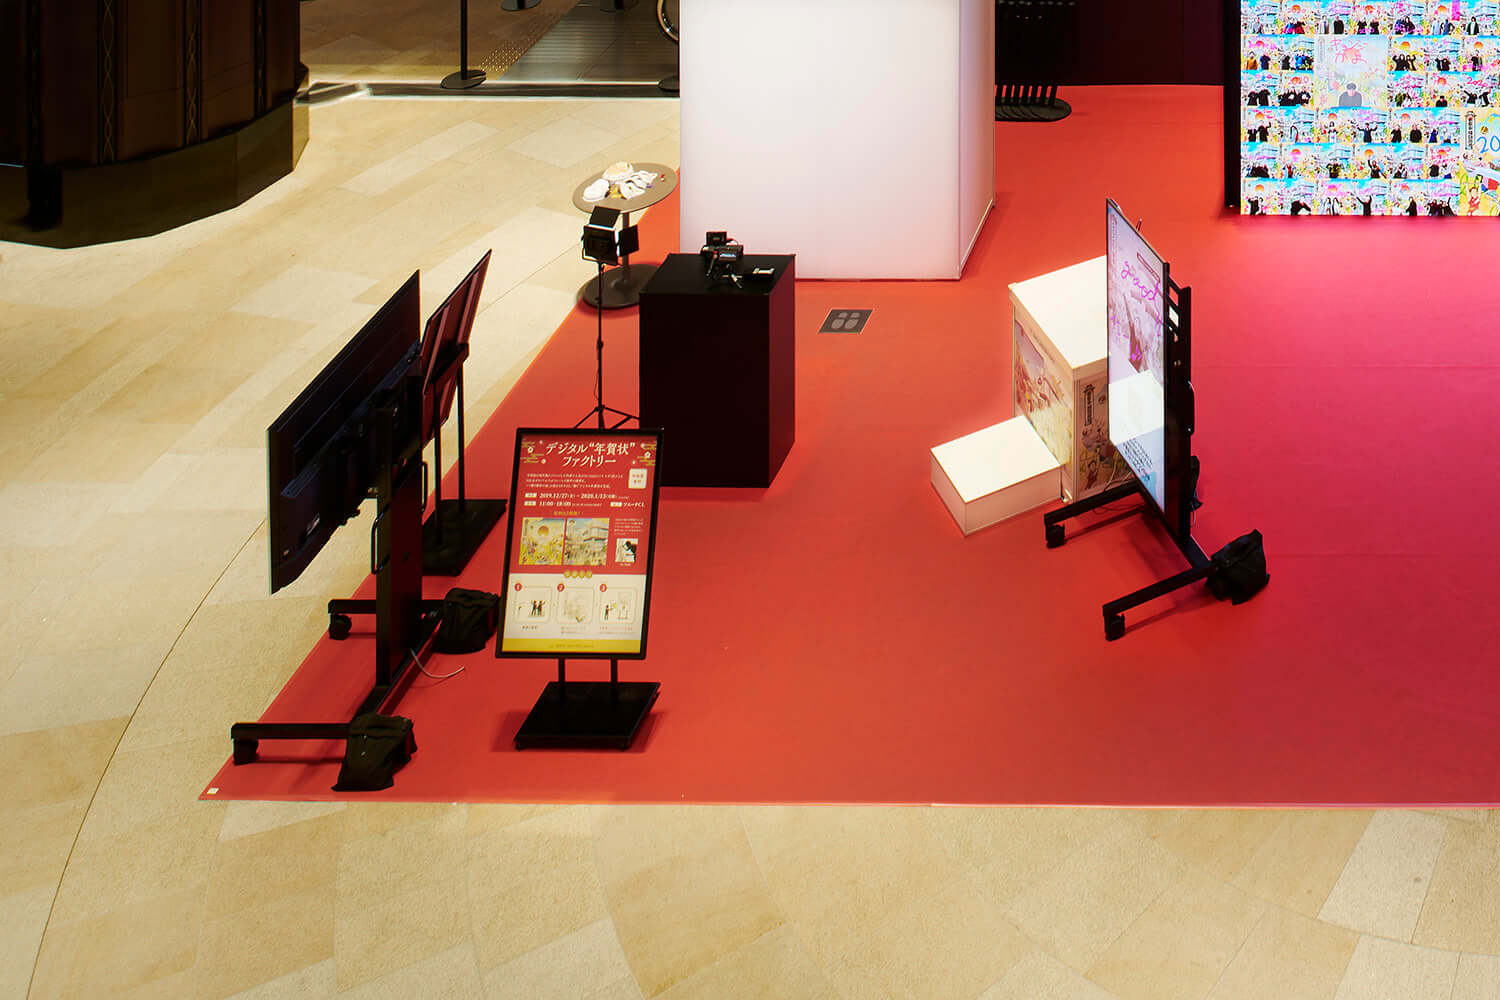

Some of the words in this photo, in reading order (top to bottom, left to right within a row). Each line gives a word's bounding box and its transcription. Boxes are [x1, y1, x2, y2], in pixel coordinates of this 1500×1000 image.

[562, 455, 617, 468] ファクトリー
